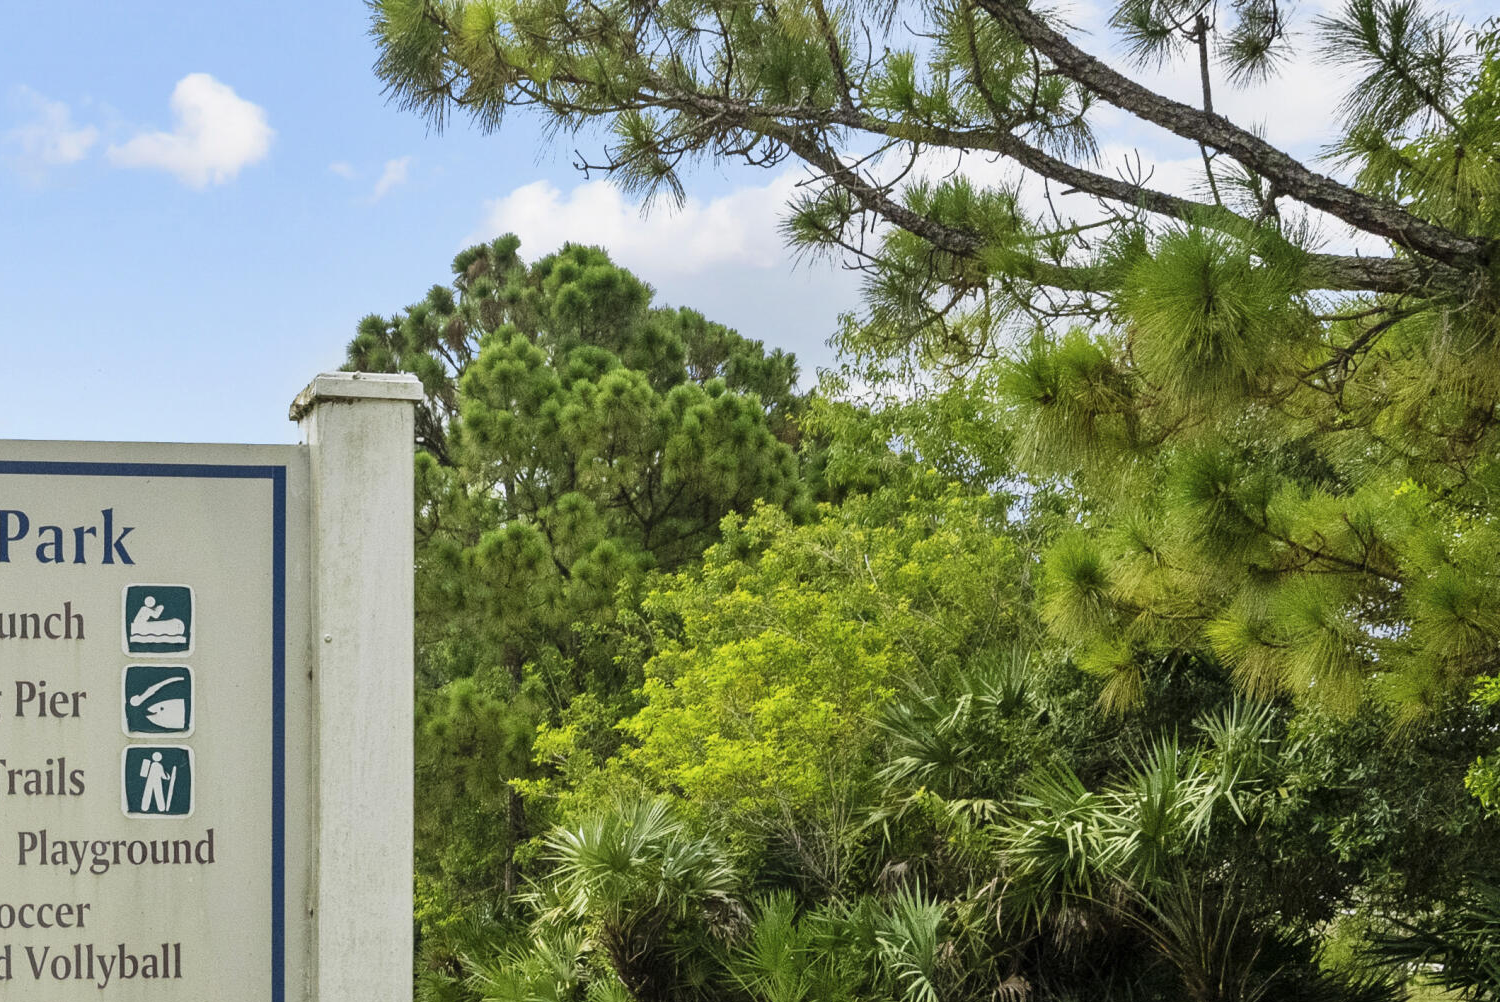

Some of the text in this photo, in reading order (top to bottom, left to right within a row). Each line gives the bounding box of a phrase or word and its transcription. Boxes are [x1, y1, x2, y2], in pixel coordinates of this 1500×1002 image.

[14, 680, 87, 719] Pier
[17, 827, 216, 876] Playground
[24, 942, 183, 990] Vollyball
